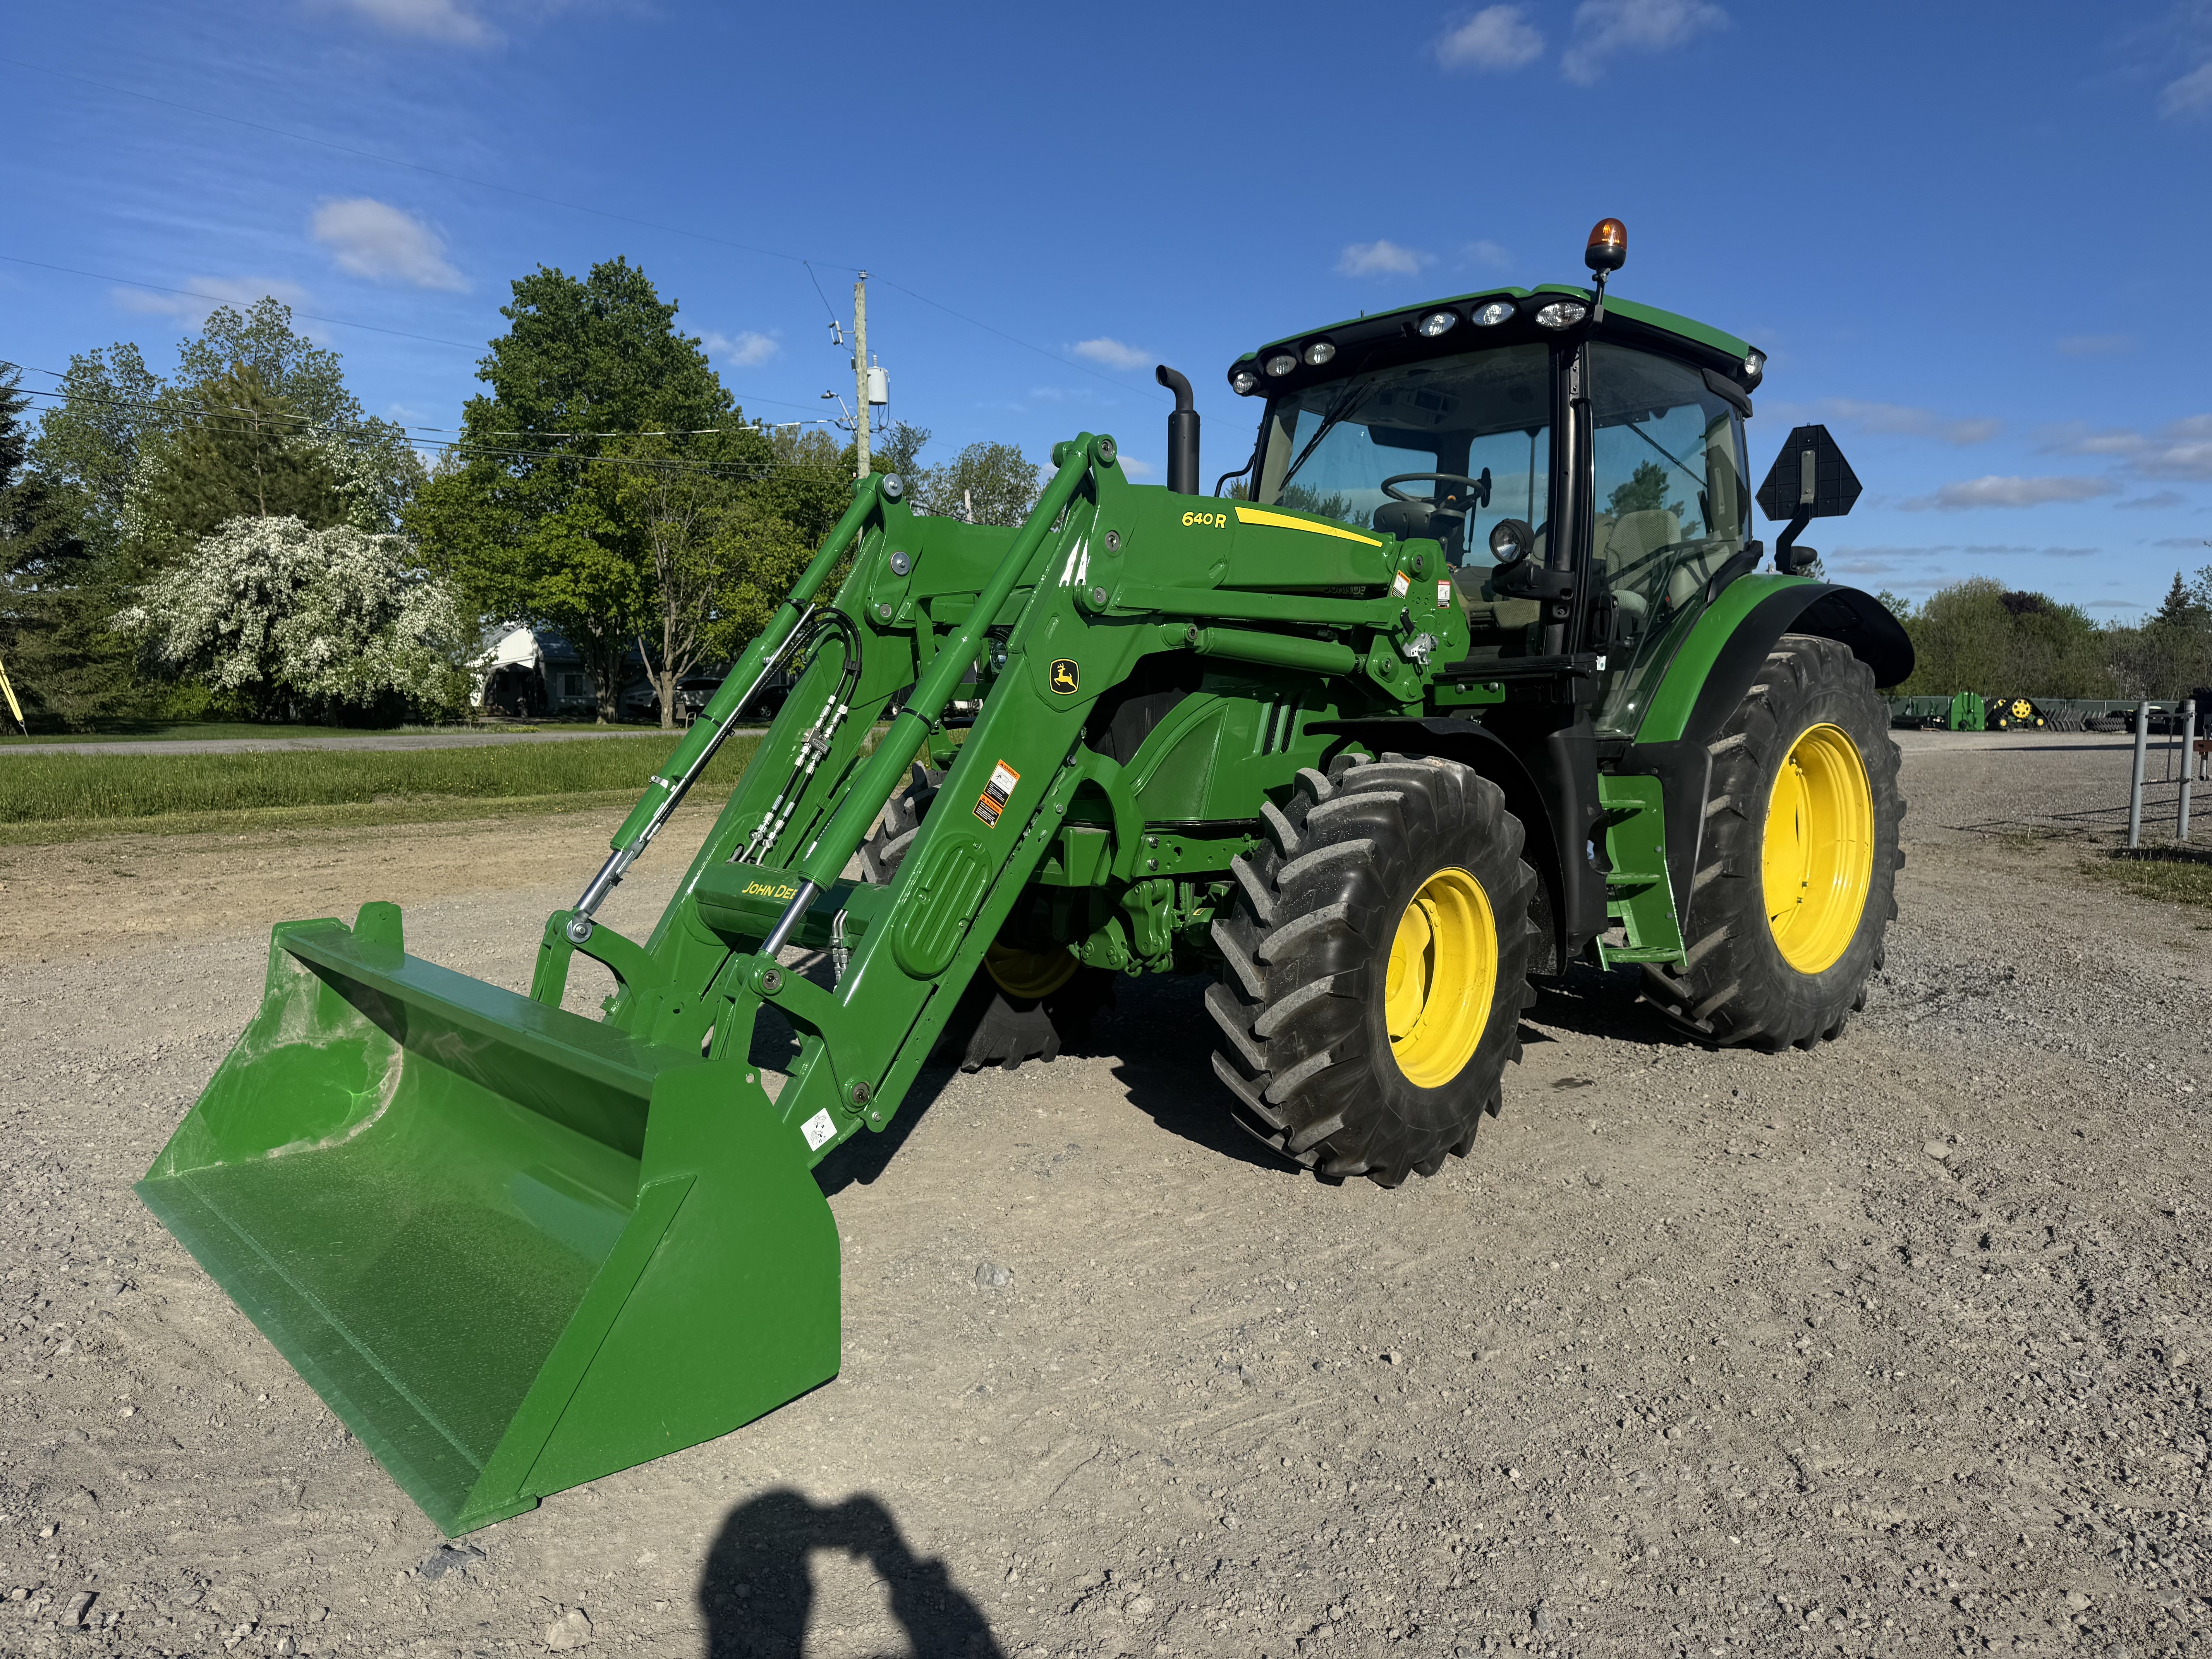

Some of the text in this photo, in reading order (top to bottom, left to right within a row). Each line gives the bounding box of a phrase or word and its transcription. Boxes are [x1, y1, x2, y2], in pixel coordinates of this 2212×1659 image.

[1182, 511, 1226, 529] 640 R
[742, 881, 798, 900] JOHN DEE
